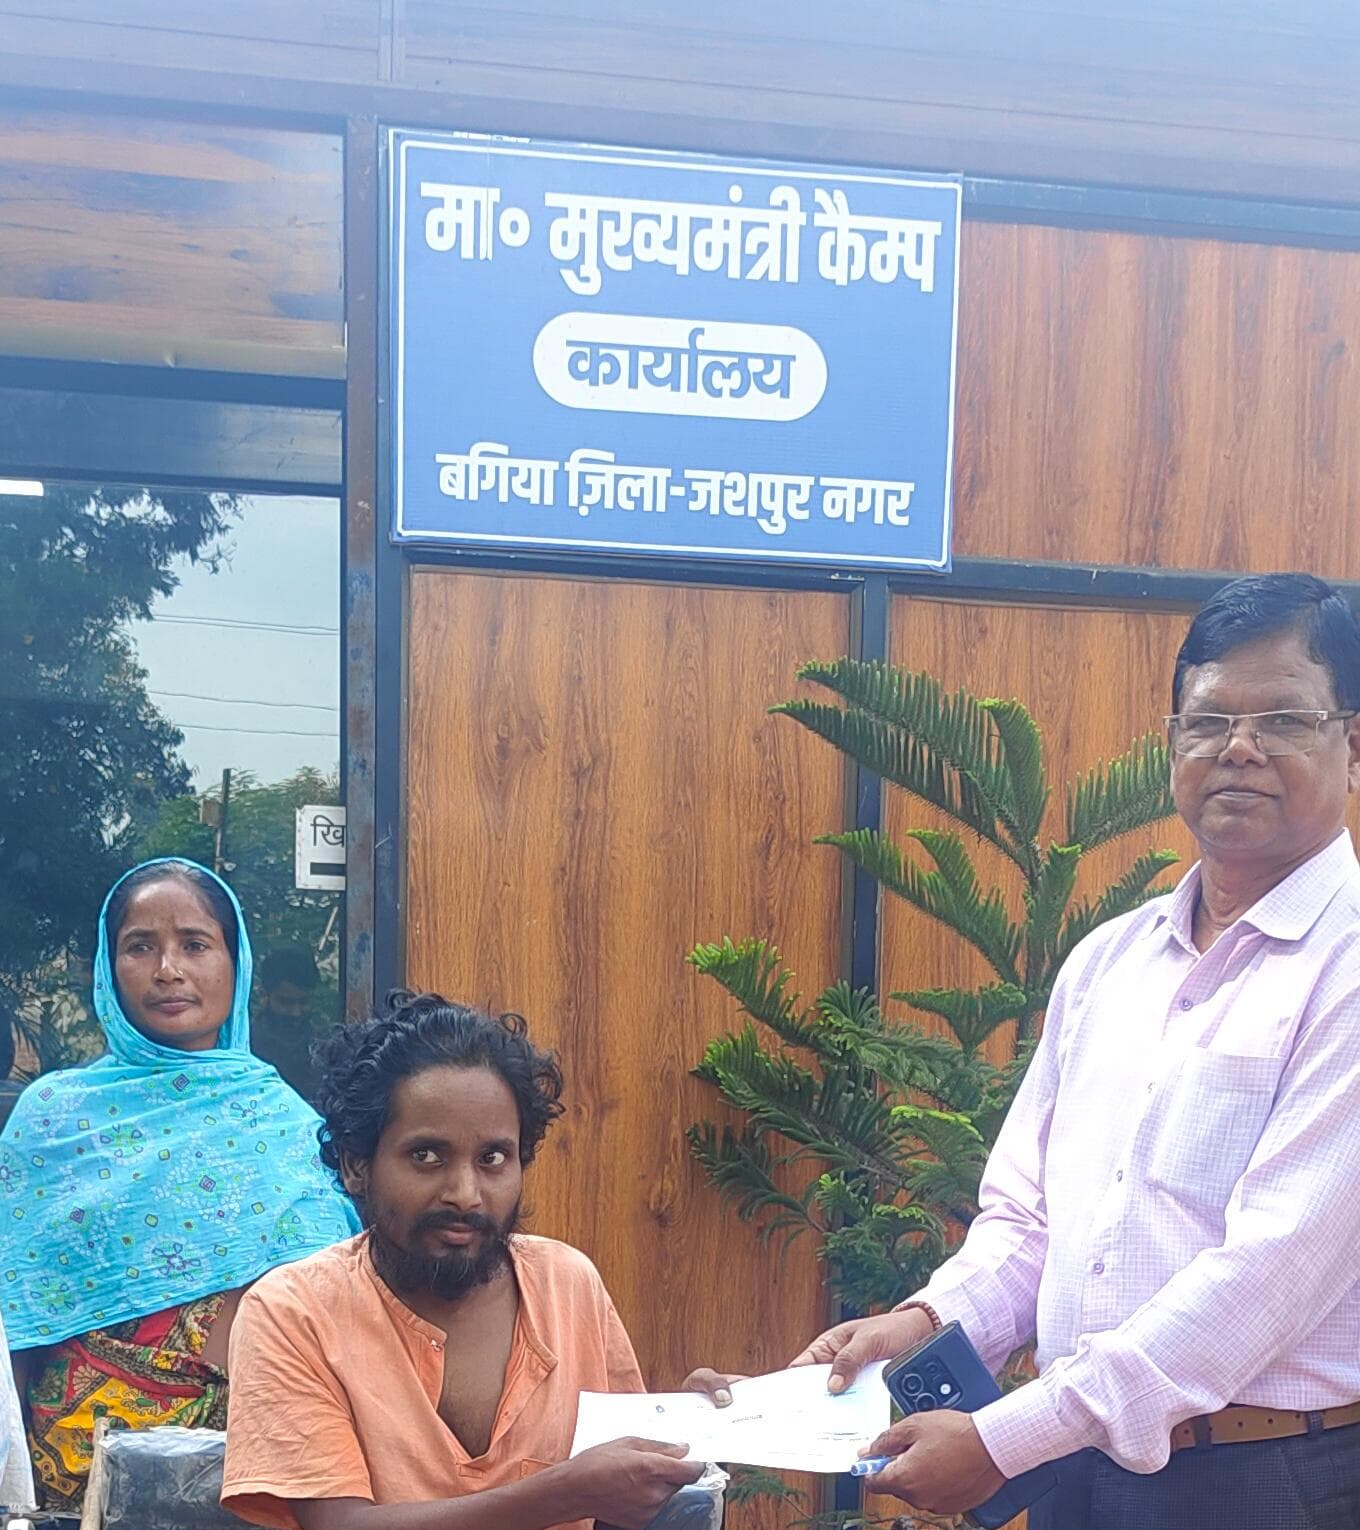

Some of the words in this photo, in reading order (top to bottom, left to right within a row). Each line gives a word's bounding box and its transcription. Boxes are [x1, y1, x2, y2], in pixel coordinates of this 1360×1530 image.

[544, 184, 807, 296] मुख्यमंत्री
[813, 187, 942, 293] कैम्प
[565, 327, 797, 400] कार्यालय
[435, 441, 560, 507] बगिया
[819, 475, 915, 527] नगर
[310, 814, 346, 848] खि
